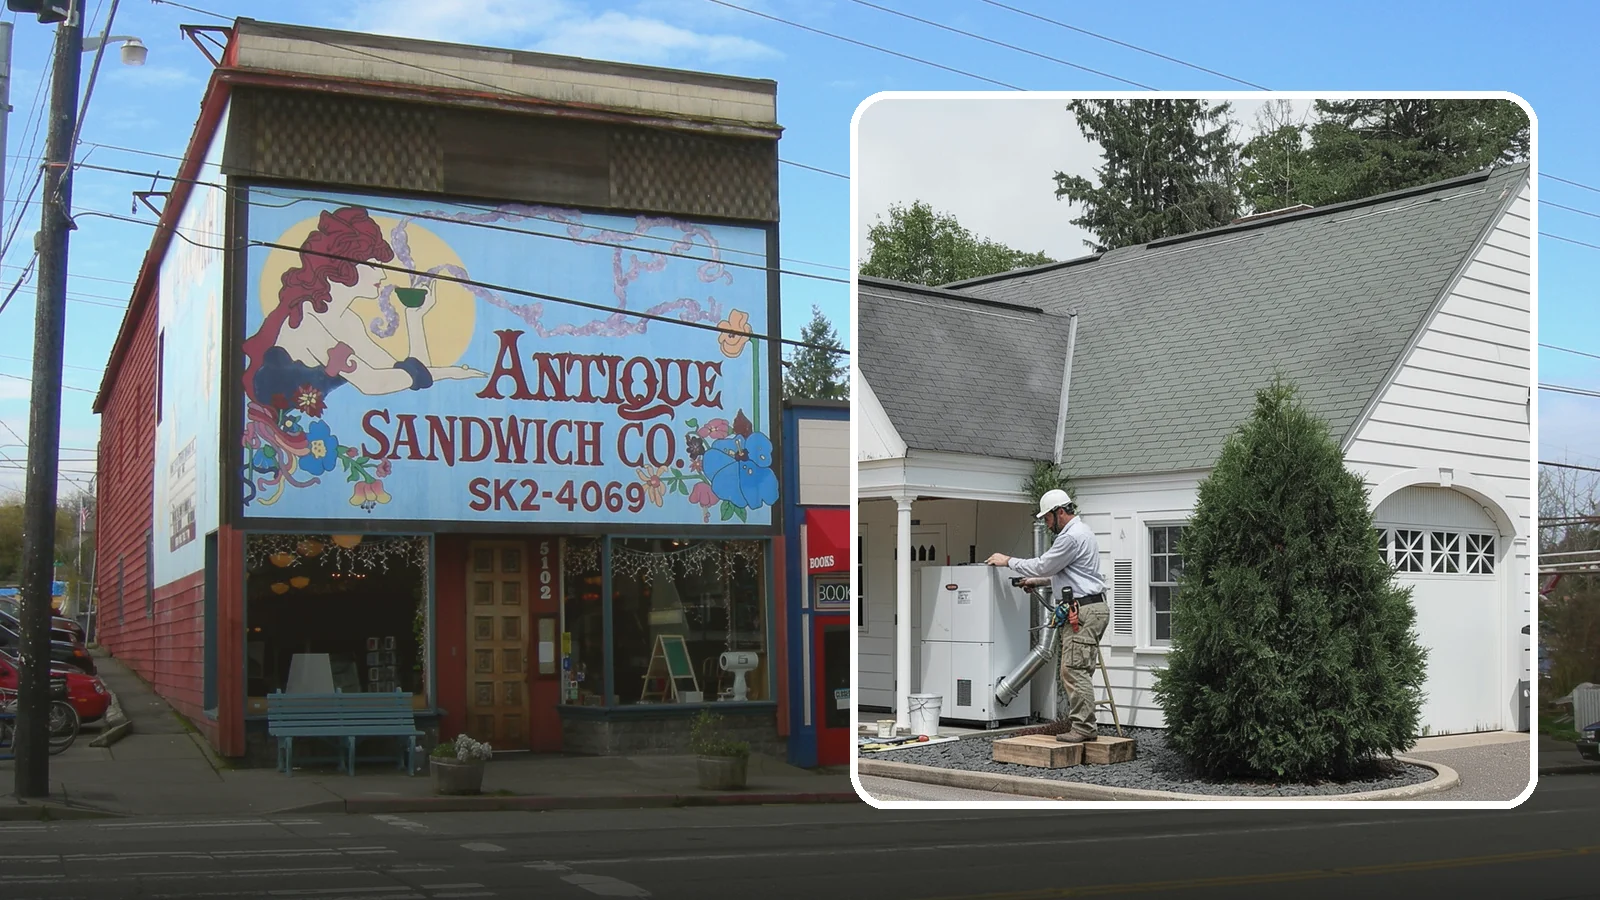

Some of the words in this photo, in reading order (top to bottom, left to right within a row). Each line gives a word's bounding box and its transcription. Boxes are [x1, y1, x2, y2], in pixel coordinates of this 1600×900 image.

[361, 409, 604, 467] SANDWICH
[617, 422, 685, 468] CO.
[469, 477, 645, 512] SK2-4069
[809, 555, 835, 569] BOOKS
